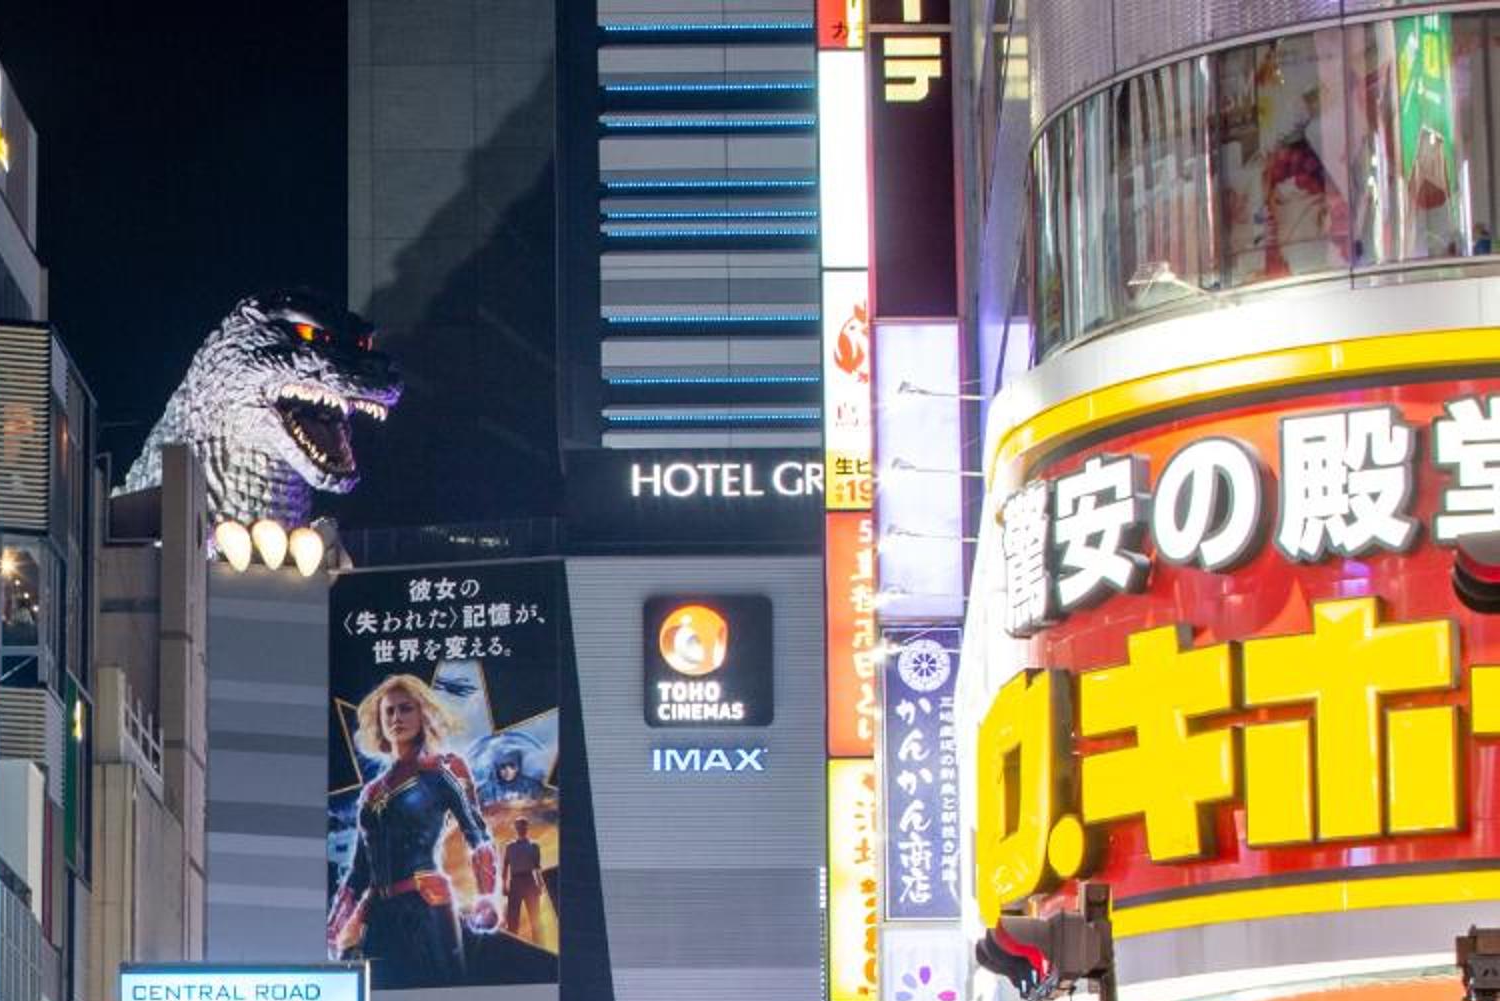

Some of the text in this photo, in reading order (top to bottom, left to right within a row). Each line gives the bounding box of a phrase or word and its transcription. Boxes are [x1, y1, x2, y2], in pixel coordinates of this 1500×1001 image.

[632, 463, 764, 497] HOTEL
[408, 577, 480, 602] 彼女の
[372, 635, 512, 664] 世界を変える。
[657, 681, 720, 702] TOHO
[657, 703, 745, 721] CINEMAS
[652, 749, 764, 771] IMAX
[896, 697, 934, 904] かんかん商店
[132, 983, 321, 1001] CENTRAL ROAD
